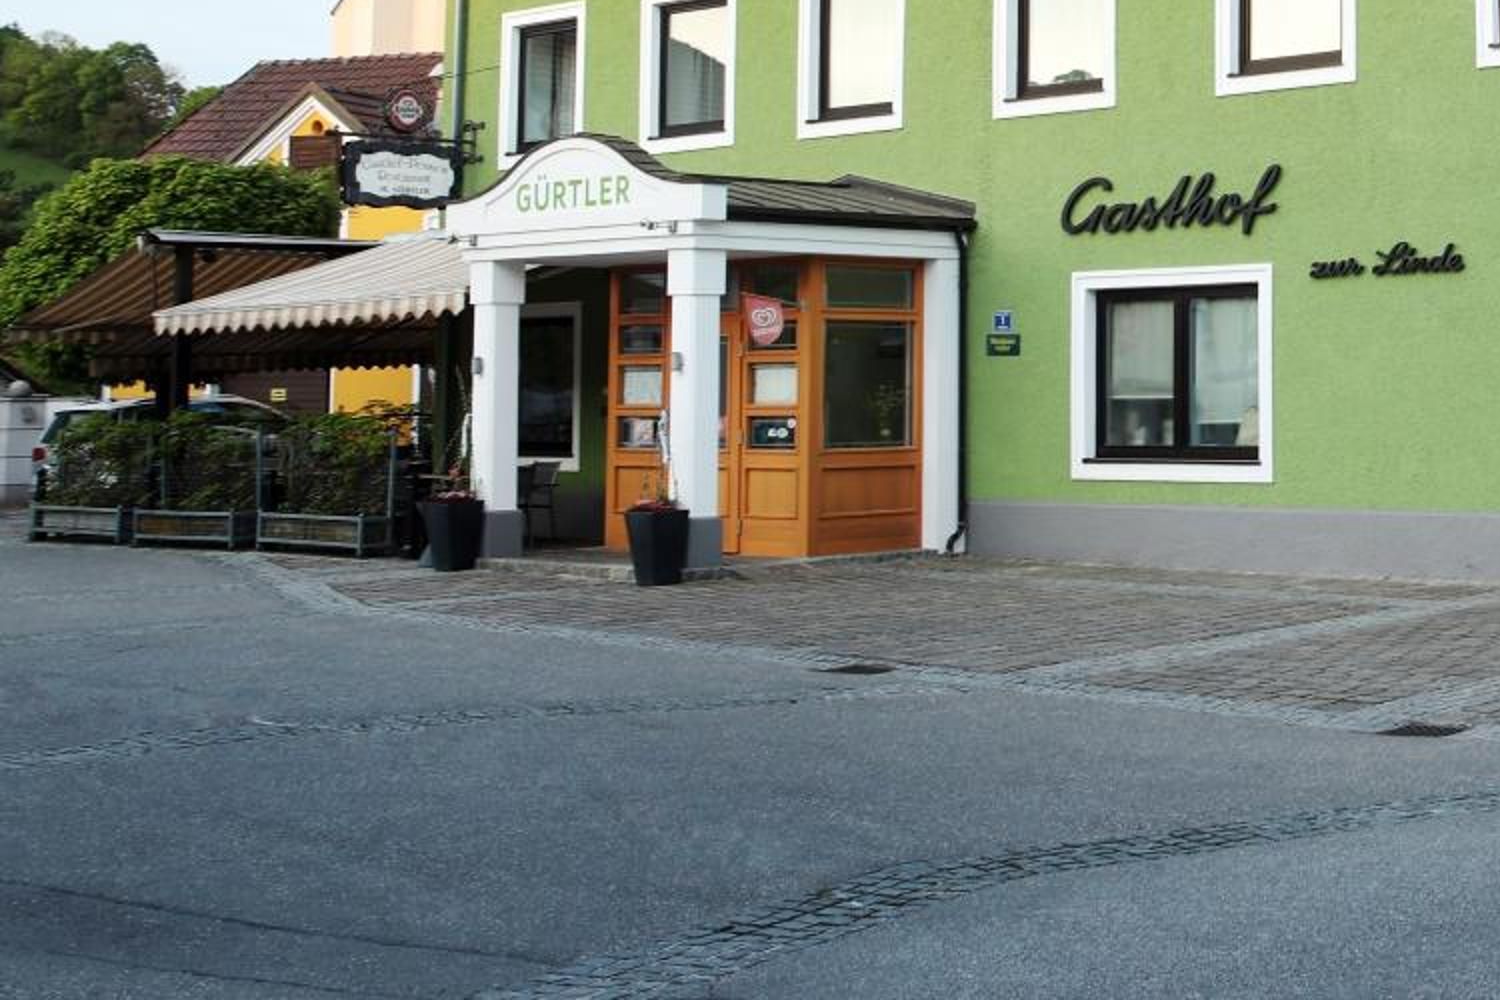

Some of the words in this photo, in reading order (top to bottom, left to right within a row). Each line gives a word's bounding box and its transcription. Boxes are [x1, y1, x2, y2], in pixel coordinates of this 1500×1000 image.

[516, 174, 631, 212] GÜRTLER
[1061, 163, 1283, 236] Gasthof
[1309, 259, 1365, 279] zur
[1372, 241, 1466, 277] Linde
